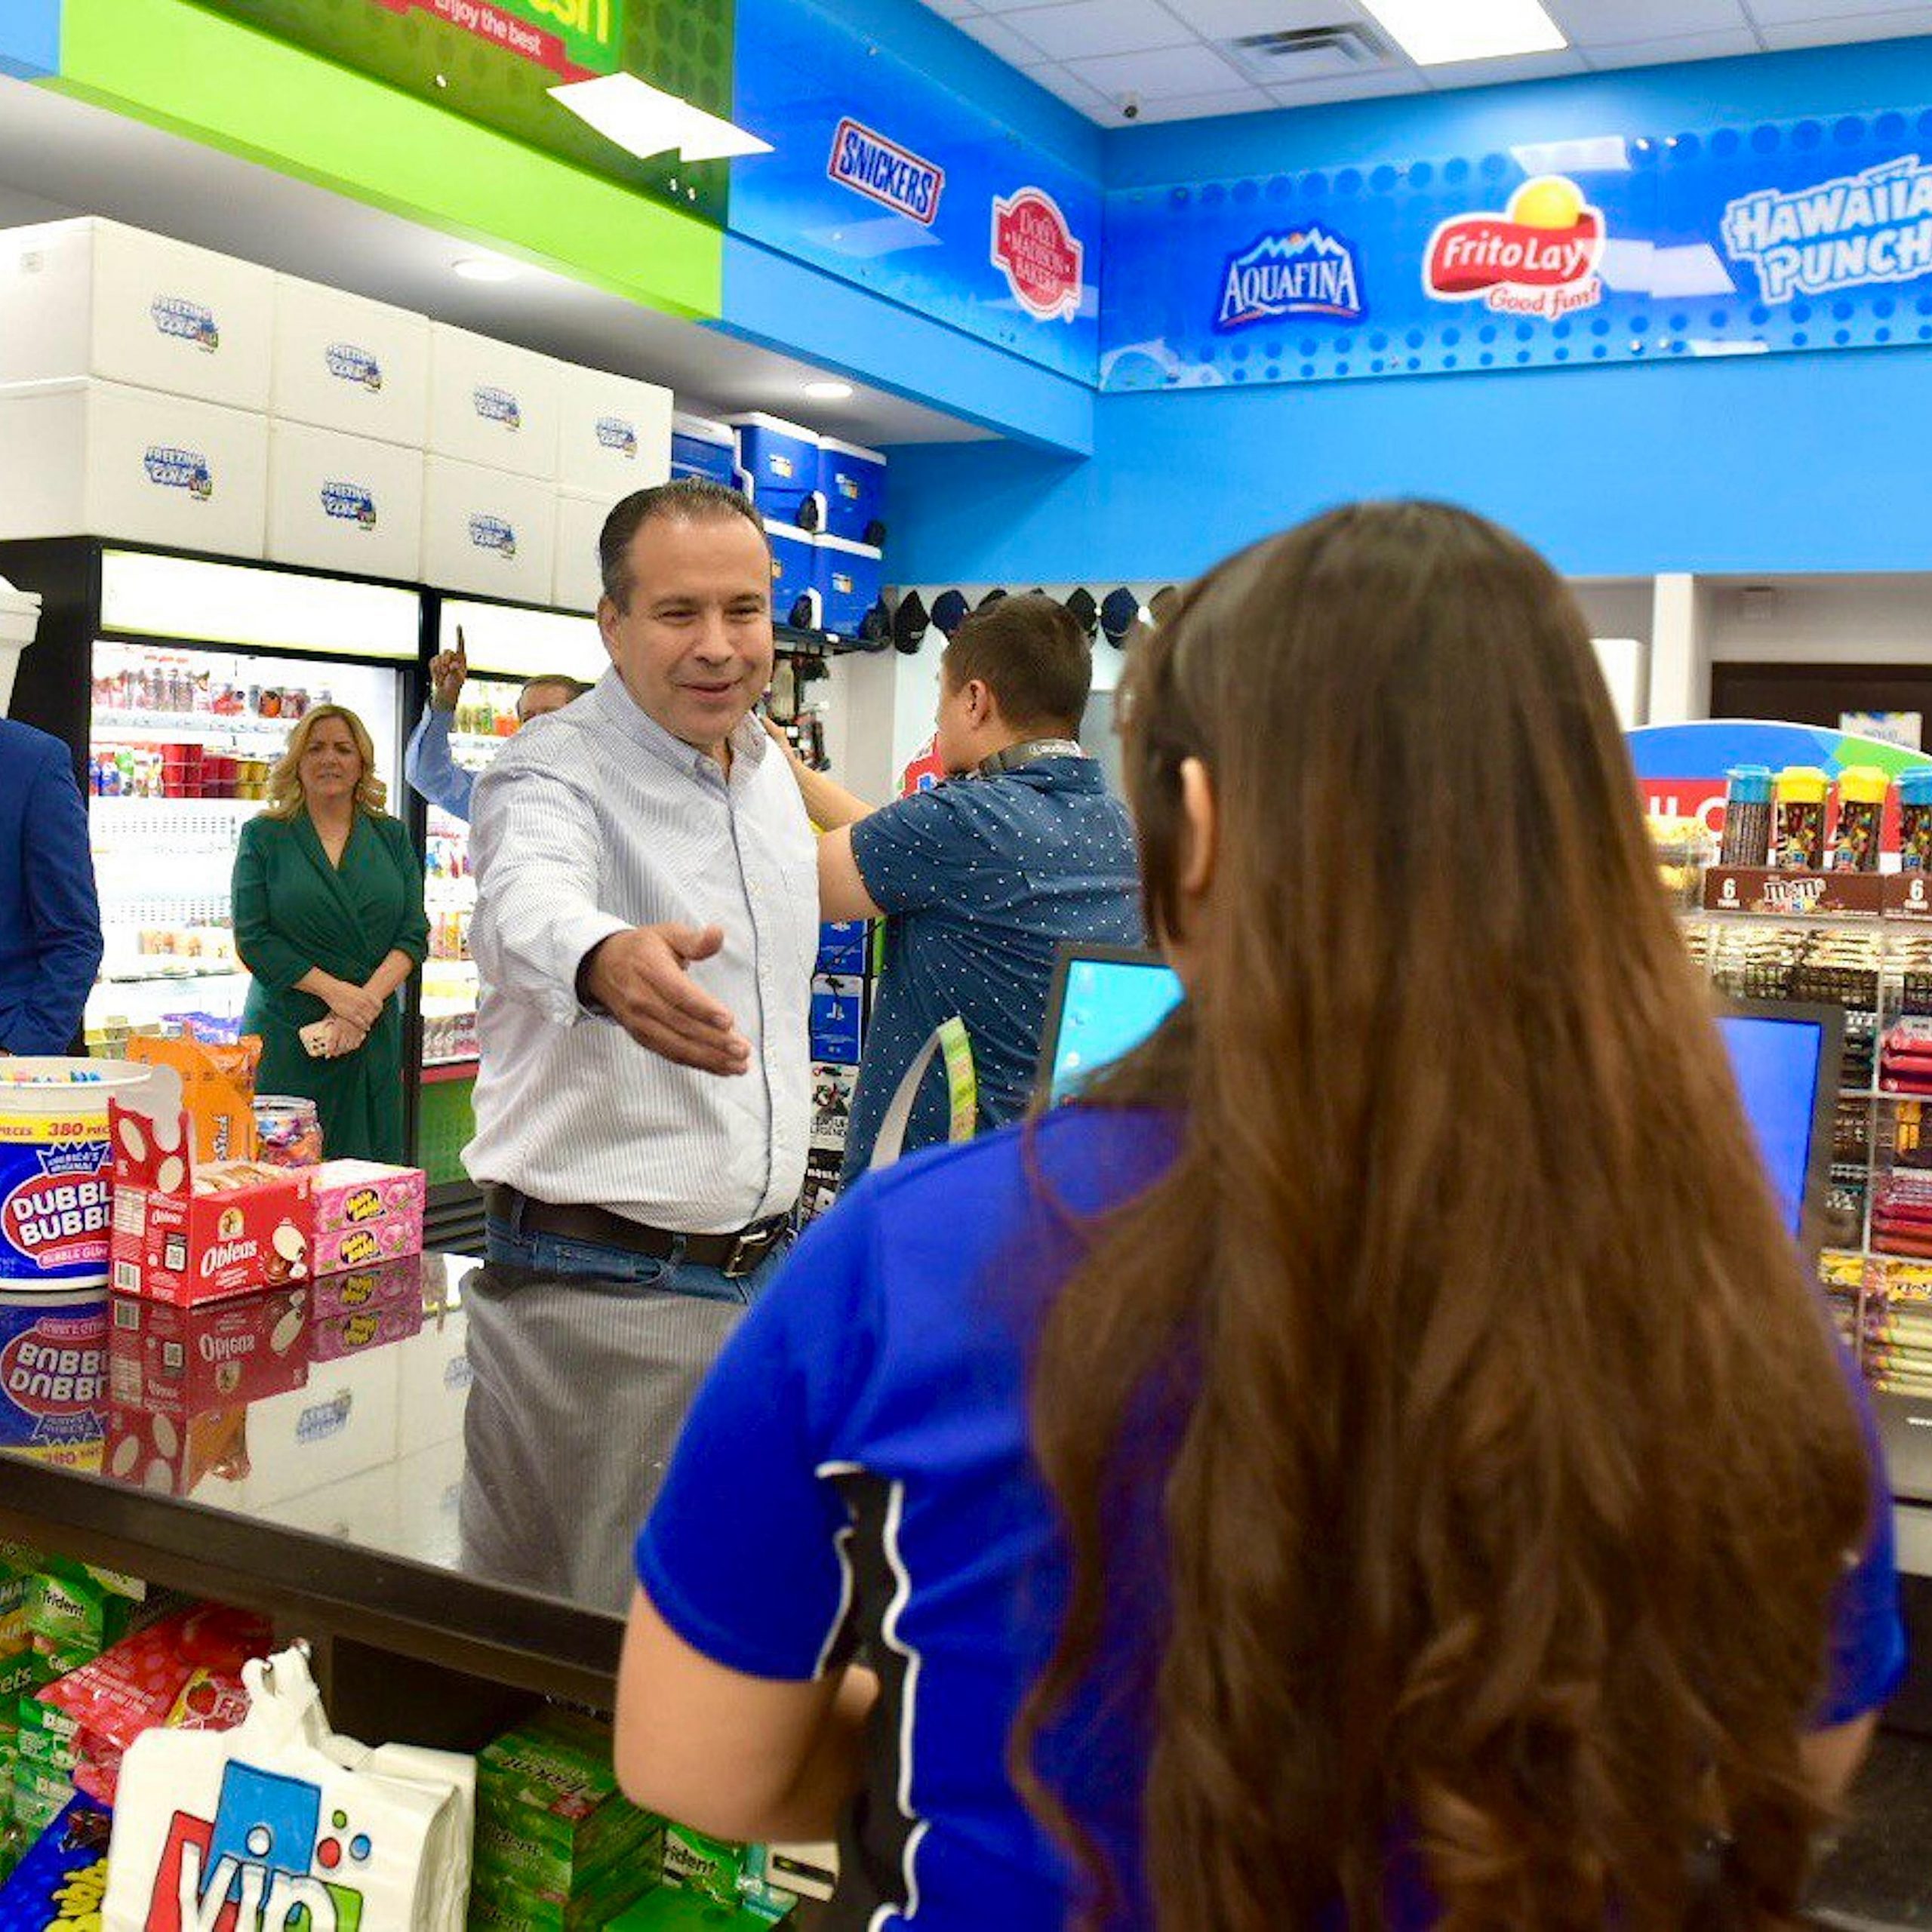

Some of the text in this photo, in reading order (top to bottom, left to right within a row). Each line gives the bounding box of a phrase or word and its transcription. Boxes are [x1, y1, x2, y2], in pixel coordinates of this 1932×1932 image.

[480, 9, 508, 38] the
[508, 22, 541, 57] best
[840, 132, 932, 214] SNICKERS
[1730, 177, 1932, 252] HAWAIIA
[1220, 253, 1361, 322] AQUAFINA
[1488, 280, 1600, 318] Good fun!
[1723, 878, 1737, 899] 6
[1910, 878, 1924, 901] 6
[47, 1122, 84, 1136] 380
[11, 1180, 113, 1222] DUBBL
[200, 1239, 258, 1278] Obleas
[42, 1589, 85, 1620] Trident
